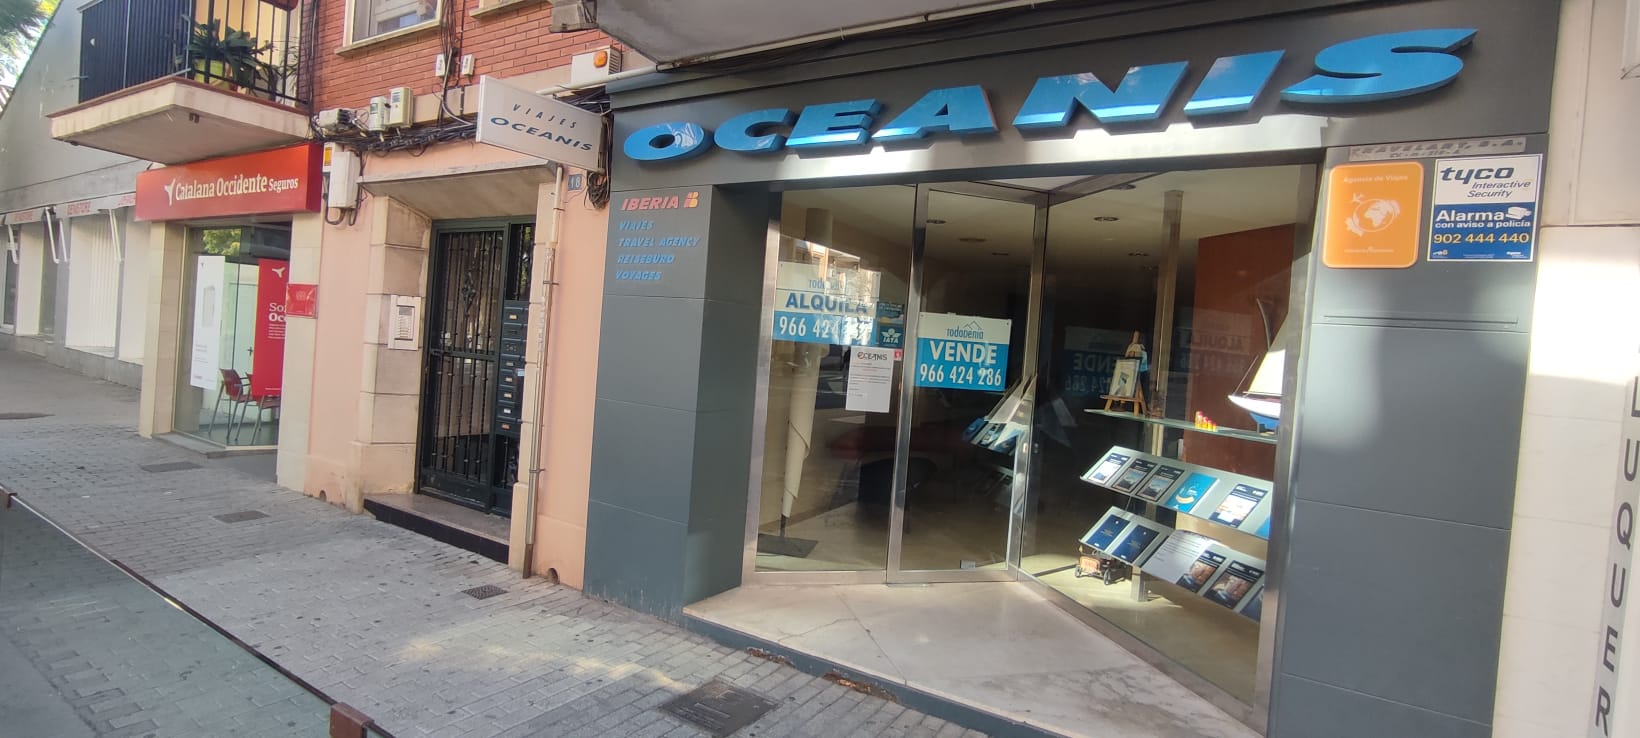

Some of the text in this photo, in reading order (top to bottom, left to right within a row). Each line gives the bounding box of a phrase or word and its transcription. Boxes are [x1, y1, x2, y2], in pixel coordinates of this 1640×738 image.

[622, 27, 1478, 163] OCEANIS
[512, 103, 577, 129] VIAJES
[490, 117, 593, 151] OCEANIS
[570, 176, 581, 188] 18
[1440, 167, 1515, 184] tyco
[175, 173, 299, 201] Catalana Occidente Seguros
[1472, 180, 1532, 189] Interactive
[1467, 189, 1513, 198] Security
[621, 195, 679, 211] IBERIA
[1436, 209, 1505, 222] Alarma
[619, 220, 655, 231] VIAJES
[1457, 220, 1485, 228] aviso
[618, 236, 700, 248] TRAVEL AGENCY
[1433, 232, 1530, 244] 902 444 440
[615, 270, 662, 281] VOYAGES
[786, 292, 867, 314] ALQUILA
[780, 316, 807, 337] 966
[882, 336, 899, 344] IATA
[930, 341, 998, 364] VENDE
[920, 364, 1001, 386] 966 424 286
